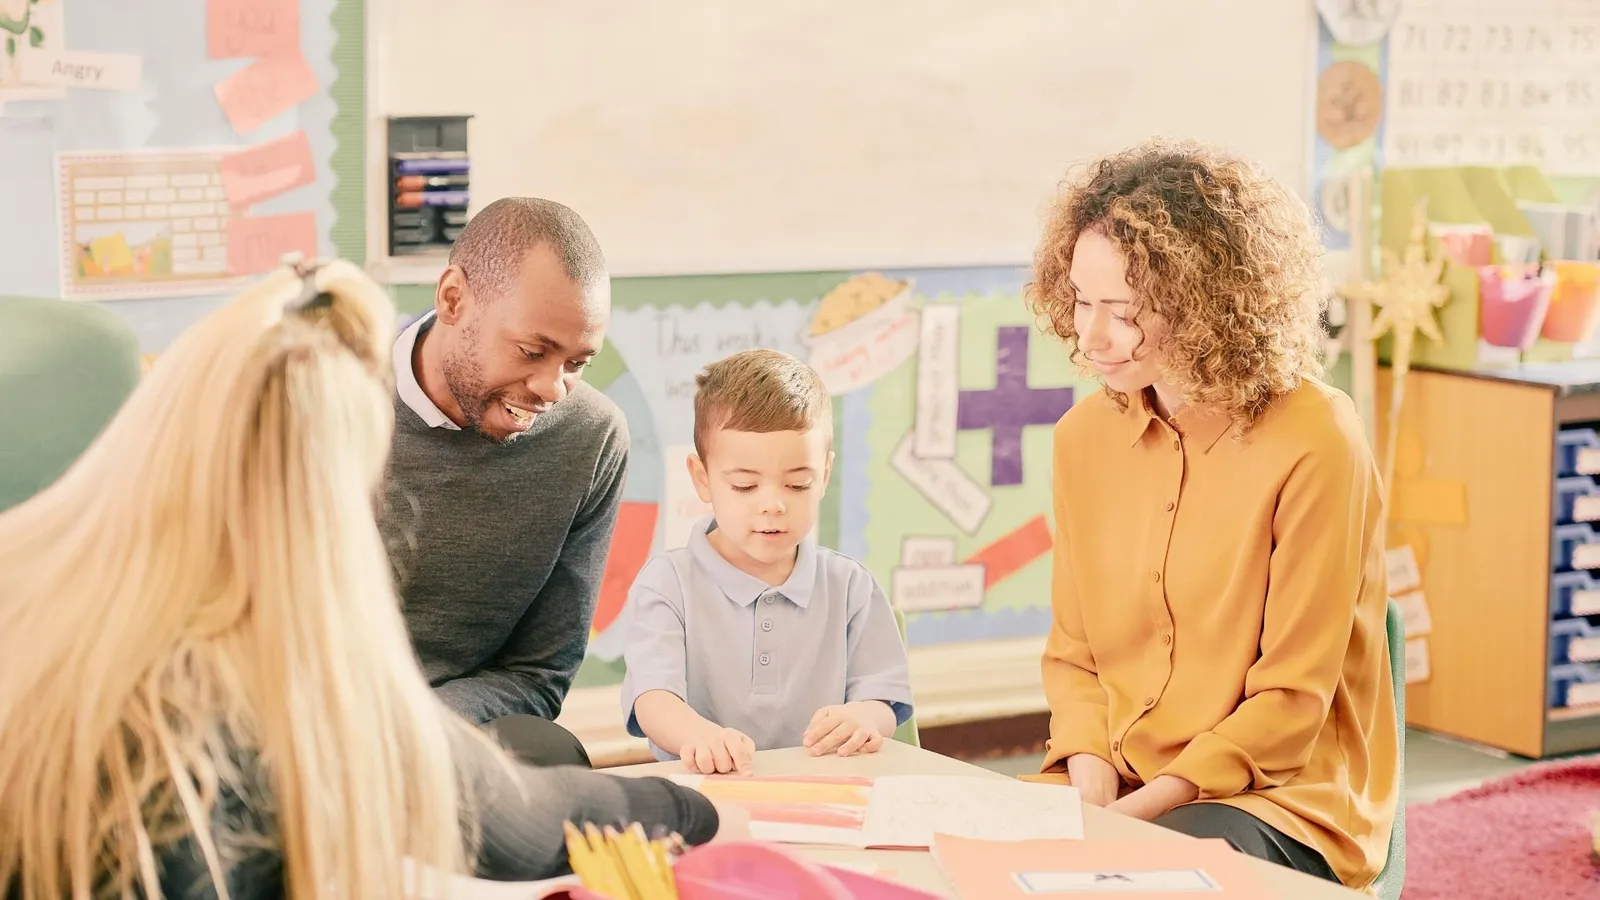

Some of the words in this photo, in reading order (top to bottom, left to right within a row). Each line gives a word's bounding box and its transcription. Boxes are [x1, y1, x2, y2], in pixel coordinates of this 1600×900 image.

[1402, 22, 1428, 52] 71
[1442, 23, 1472, 54] 72
[1484, 23, 1515, 54] 73
[51, 59, 104, 81] Angry
[655, 312, 700, 356] This
